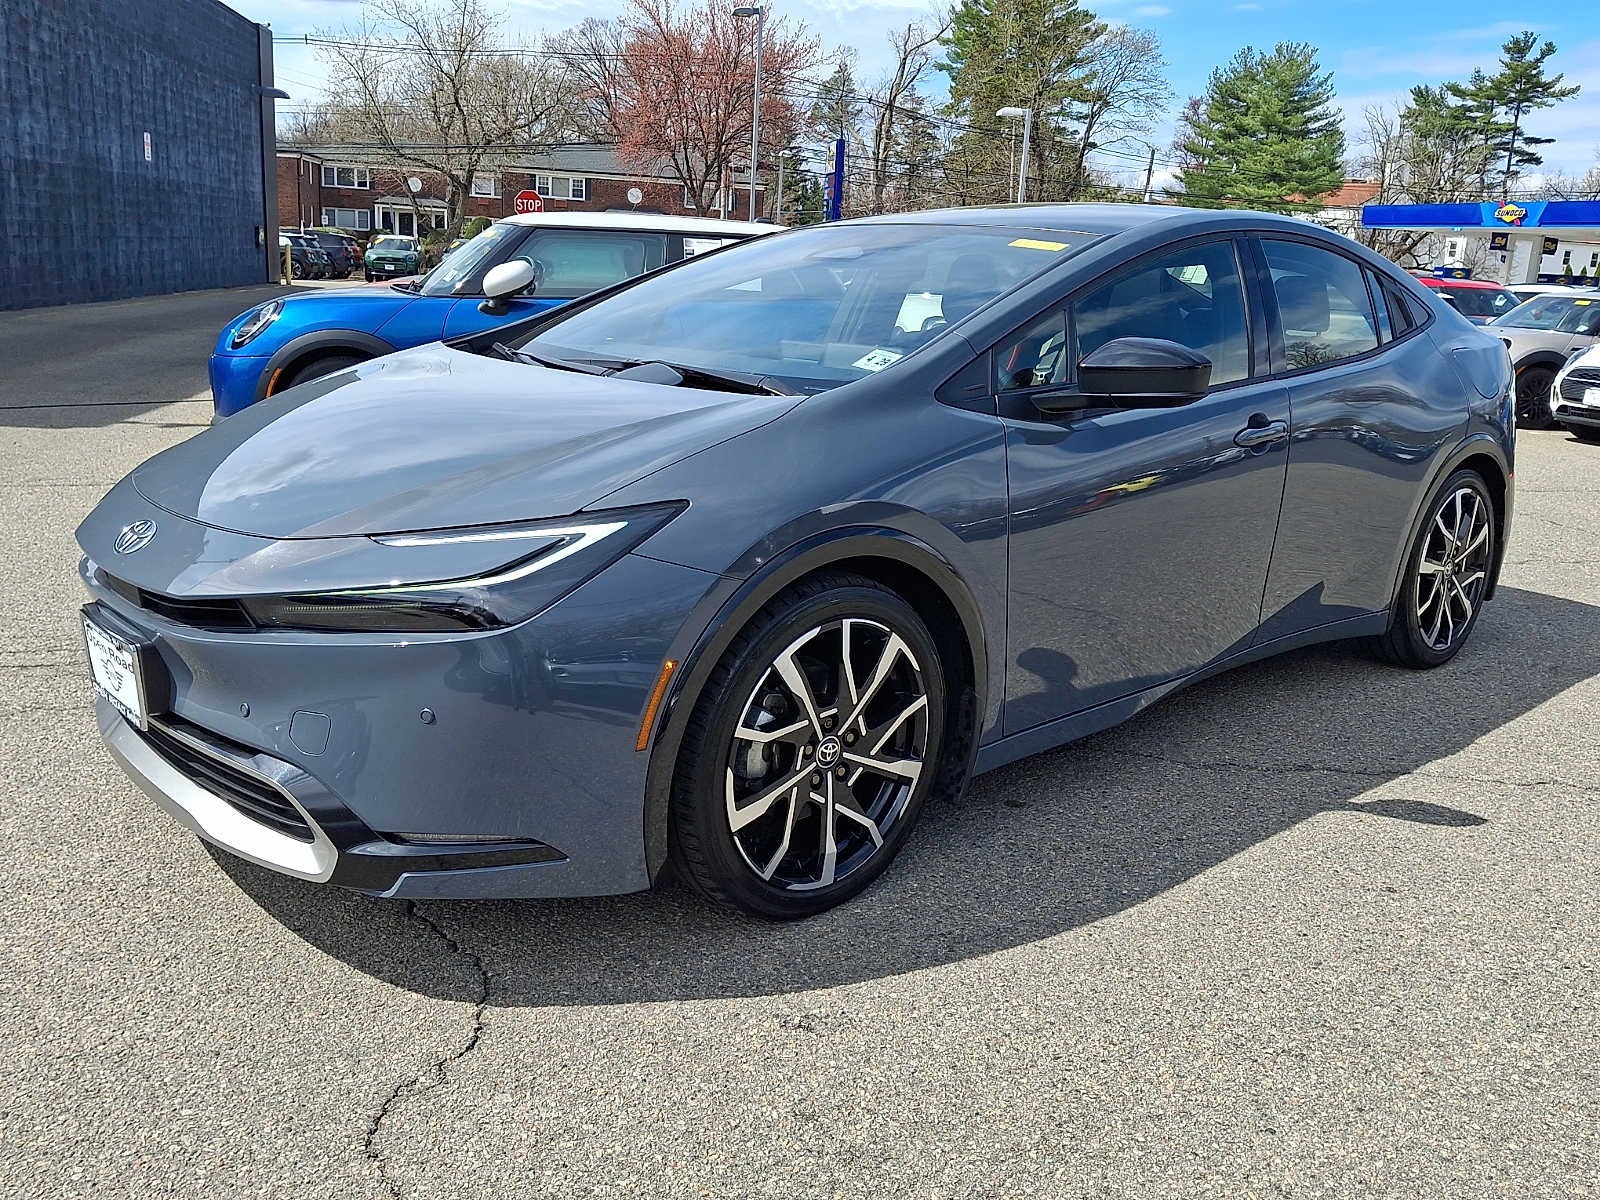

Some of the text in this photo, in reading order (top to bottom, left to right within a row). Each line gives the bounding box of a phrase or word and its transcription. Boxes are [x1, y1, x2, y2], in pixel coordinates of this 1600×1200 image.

[516, 199, 542, 212] STOP
[1496, 209, 1525, 217] SUNOCO
[107, 647, 135, 674] Road
